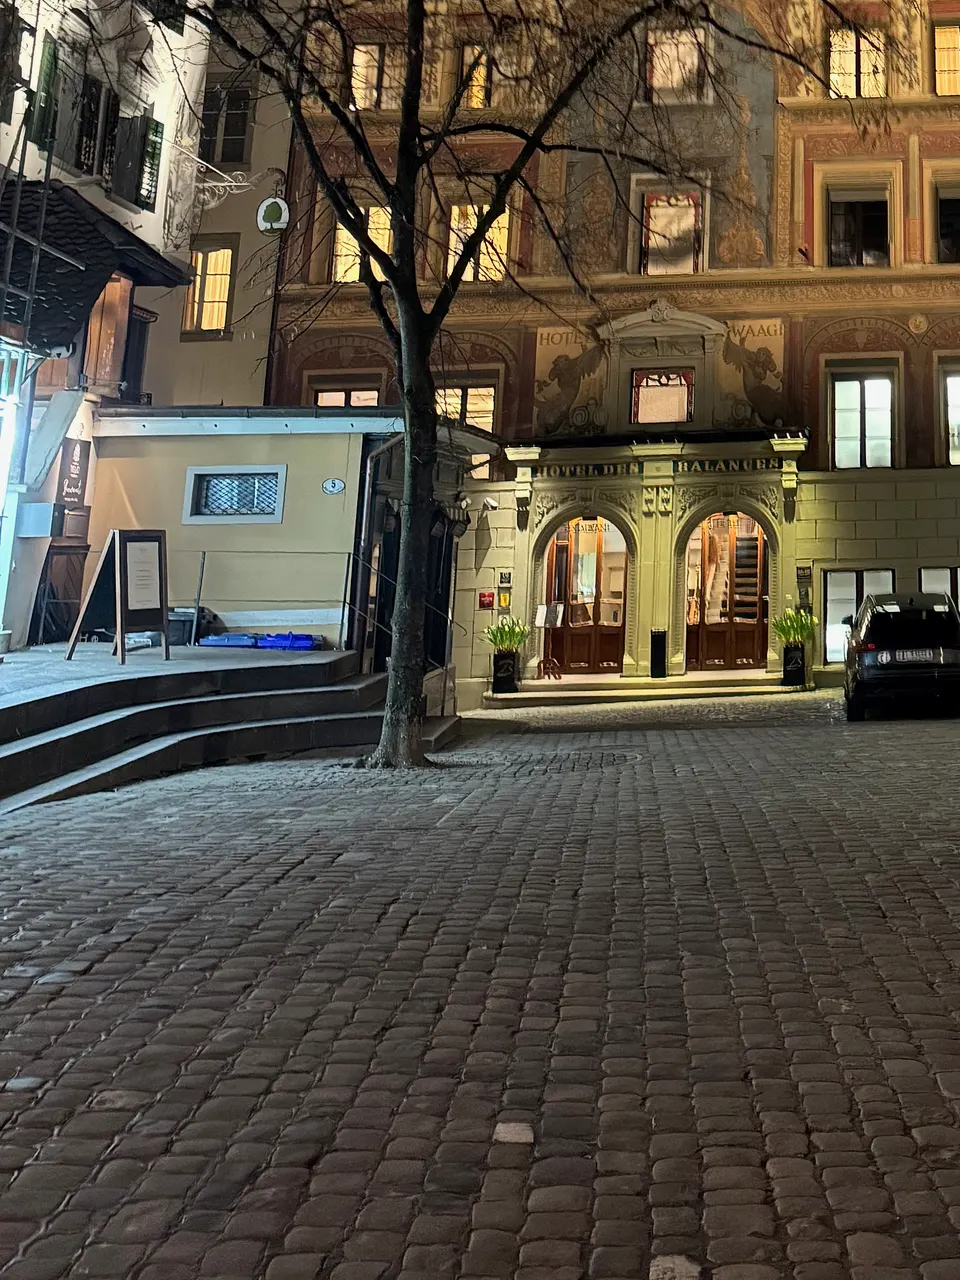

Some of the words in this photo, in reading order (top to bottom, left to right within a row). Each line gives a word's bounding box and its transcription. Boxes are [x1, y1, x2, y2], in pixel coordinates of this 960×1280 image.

[537, 464, 598, 479] HOTEL
[603, 462, 639, 475] DES
[677, 458, 780, 472] BALANCES
[331, 479, 337, 489] 5
